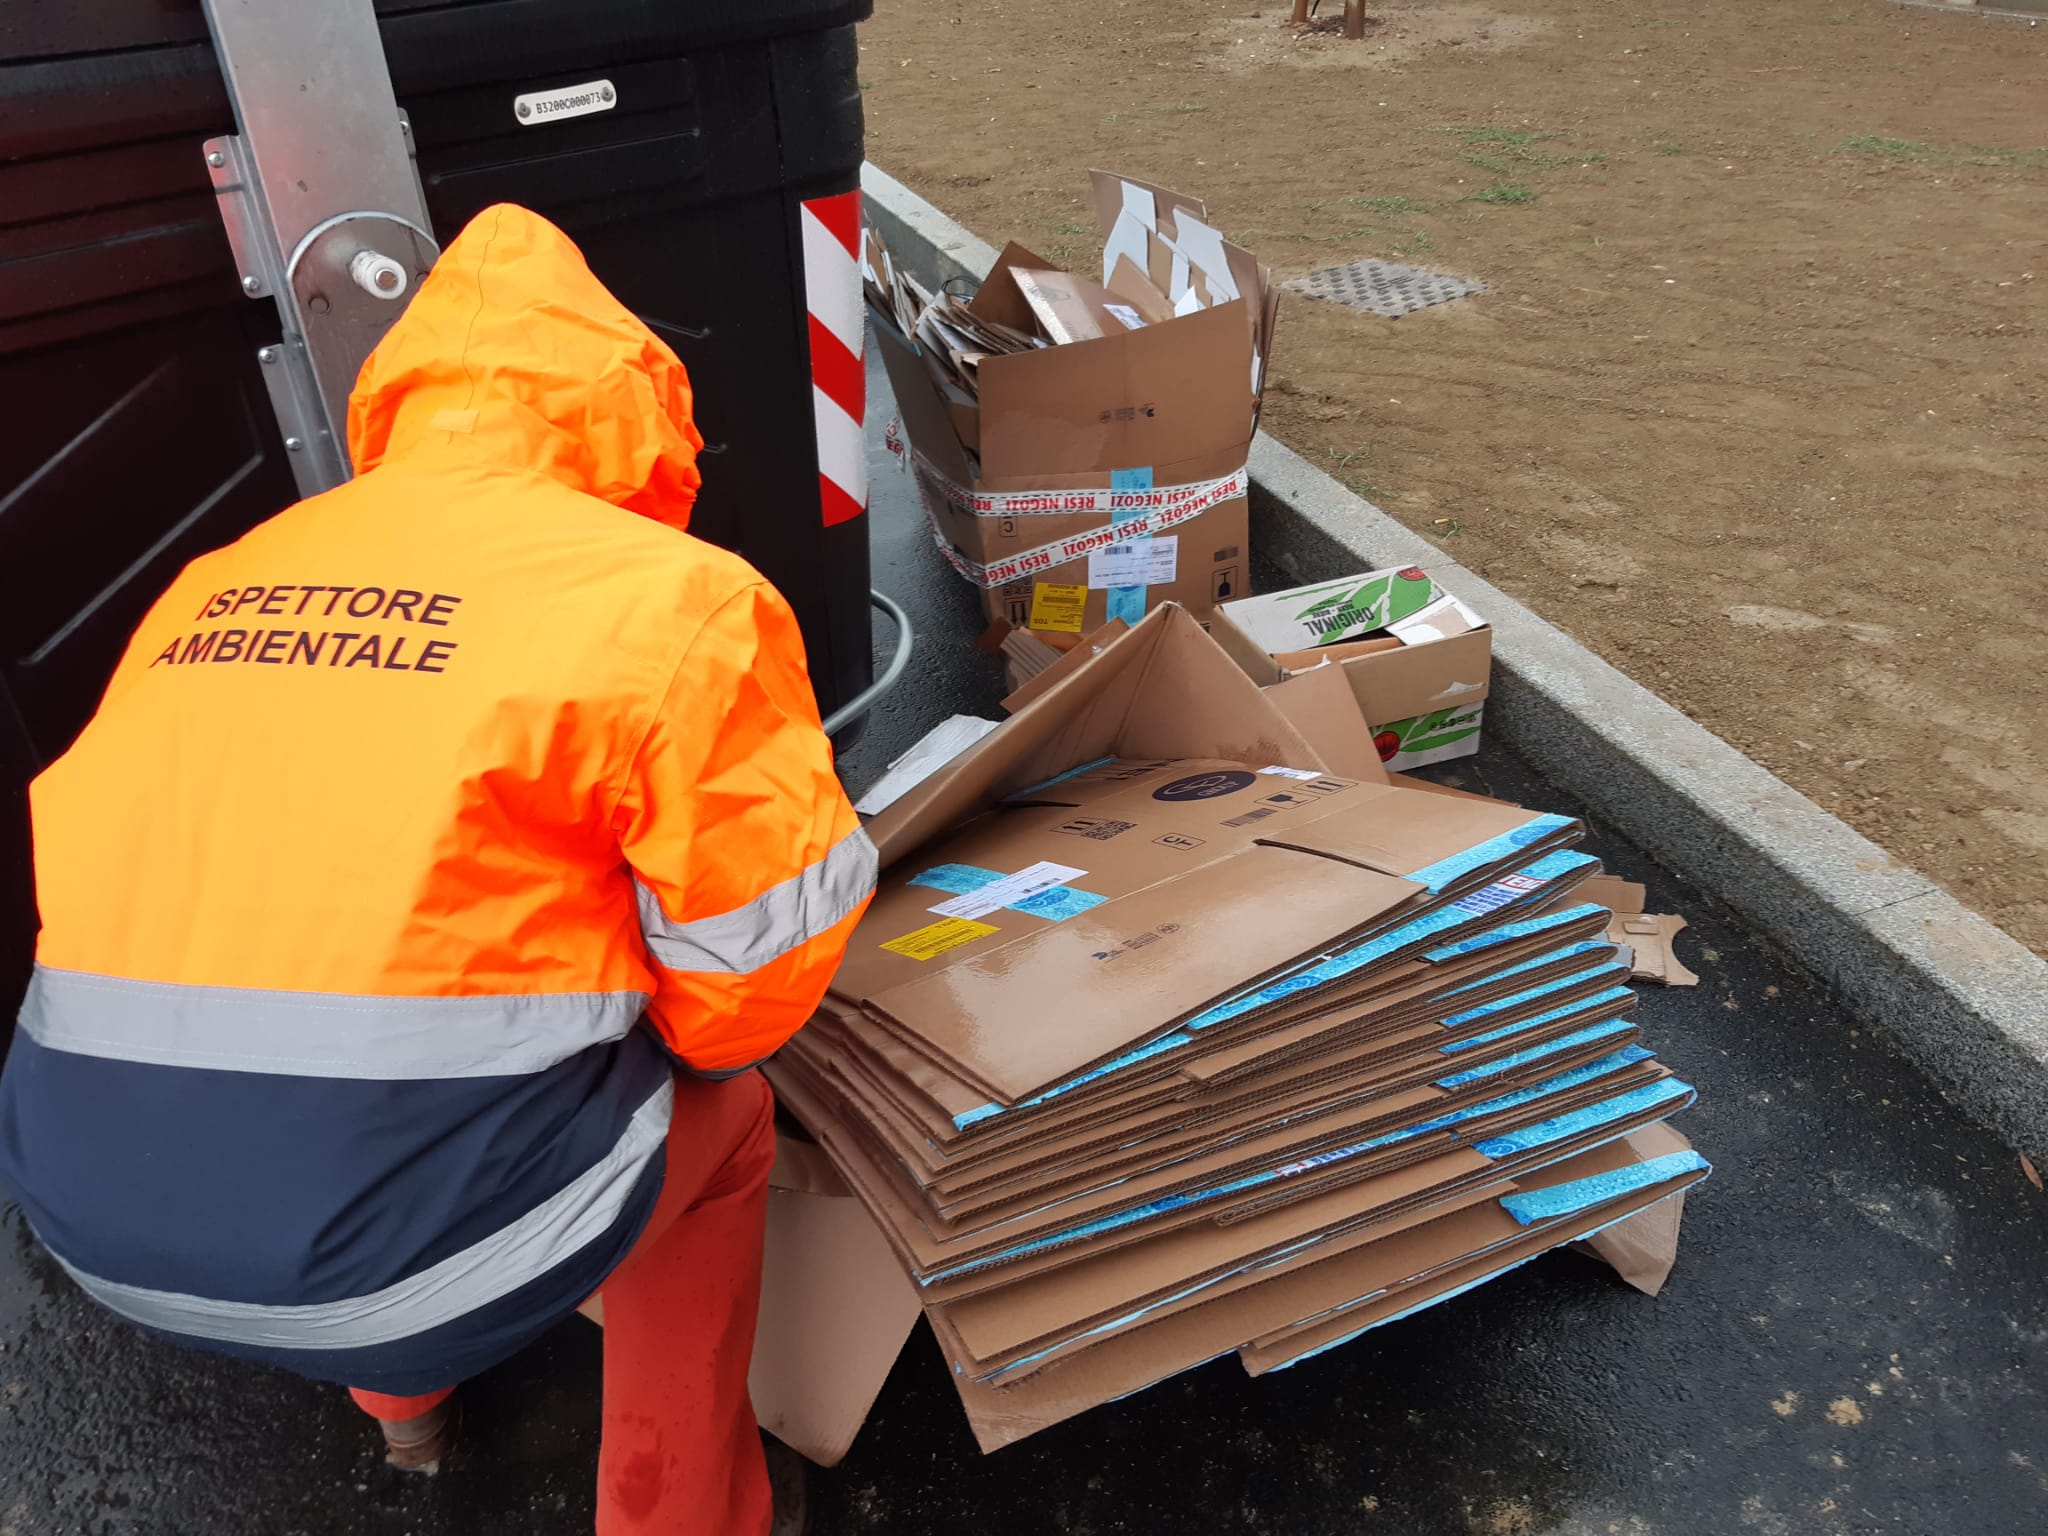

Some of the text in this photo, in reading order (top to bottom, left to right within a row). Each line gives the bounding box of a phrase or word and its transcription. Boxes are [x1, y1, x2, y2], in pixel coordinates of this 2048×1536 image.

[1212, 480, 1237, 499] RESI
[1005, 497, 1058, 511] NEGOZI
[1064, 496, 1095, 509] RESI
[1111, 493, 1162, 507] NEGOZI
[1161, 495, 1208, 524] NEGOZI
[1118, 520, 1149, 539] RESI
[1063, 530, 1114, 556] NEGOZI
[1020, 552, 1051, 571] RESI
[195, 585, 463, 627] ISPETTORE
[1302, 607, 1375, 636] ORIGINAL
[148, 629, 459, 673] AMBIENTALE
